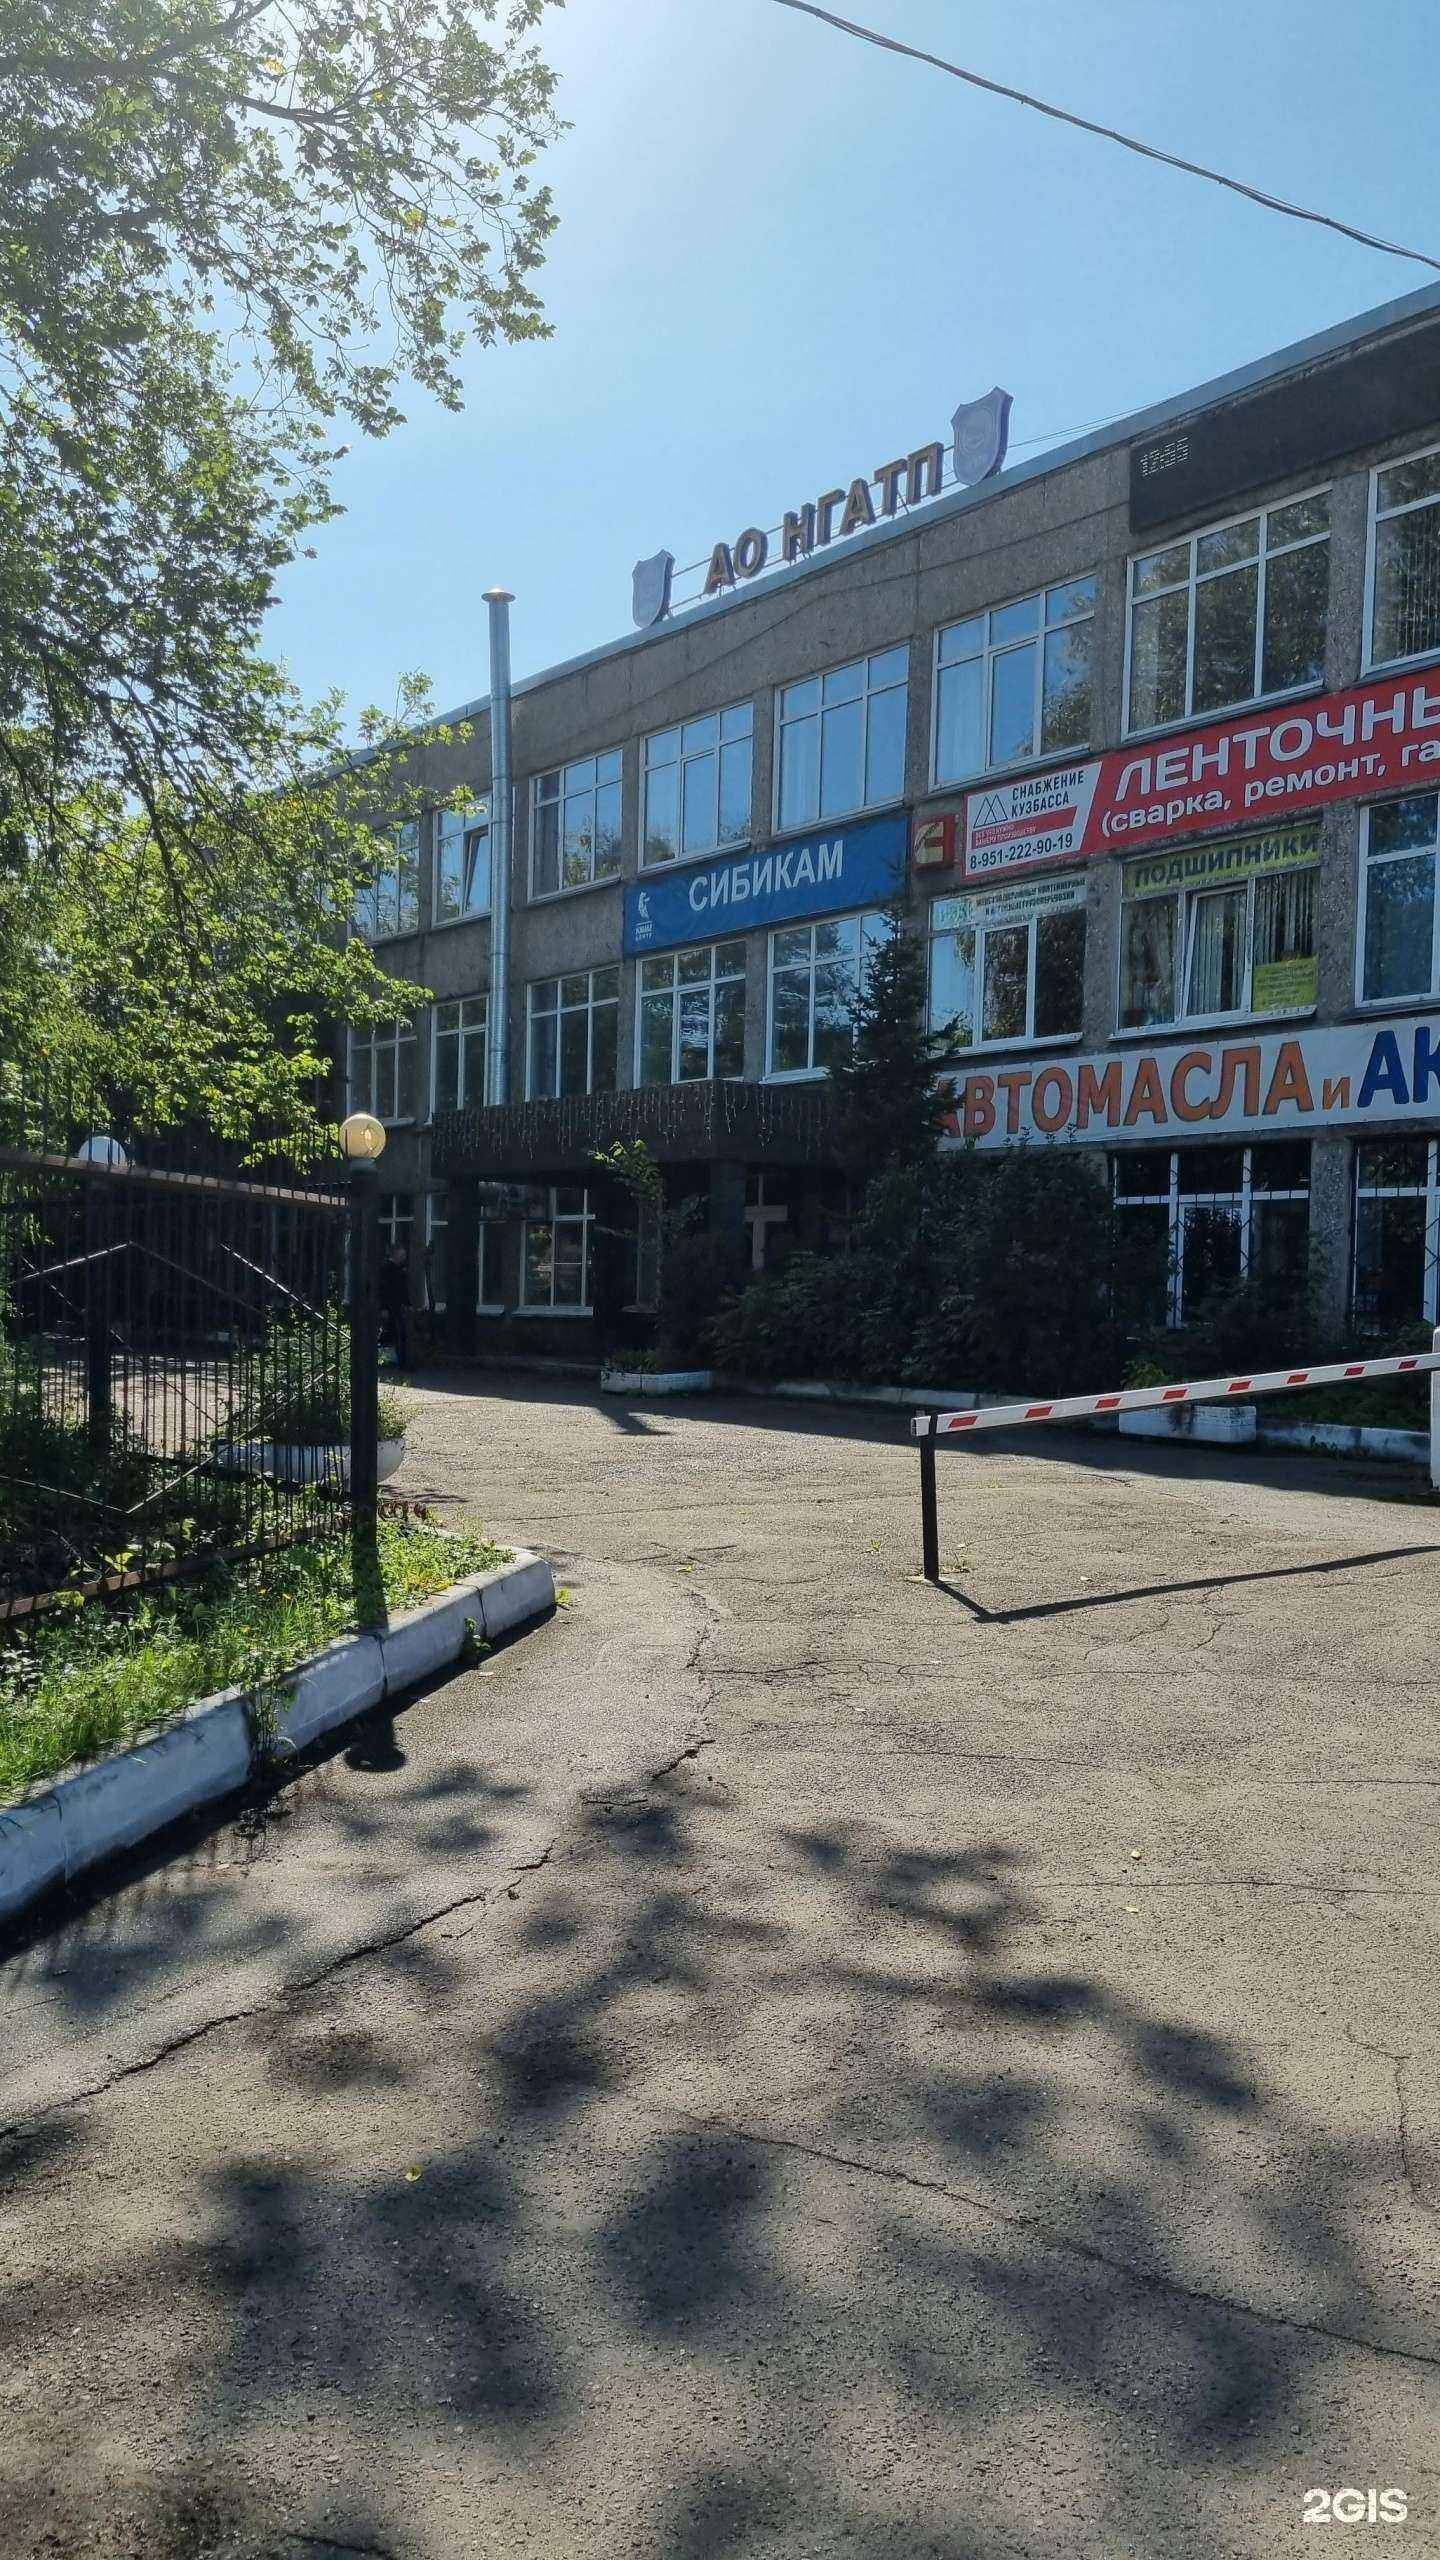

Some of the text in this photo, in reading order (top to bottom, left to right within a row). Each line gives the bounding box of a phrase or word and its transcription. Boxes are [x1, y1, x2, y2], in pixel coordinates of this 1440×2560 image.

[702, 441, 944, 597] АО НГАТП
[1012, 770, 1084, 801] СНАБЖЕНИЕ
[1102, 790, 1231, 838] (сварка,
[1244, 754, 1387, 807] ремонт,
[1011, 791, 1070, 819] КУЗБАССА
[970, 832, 1073, 870] 8-951-222-90-19
[688, 839, 844, 911] СИБИКАМ
[1322, 1076, 1350, 1110] и
